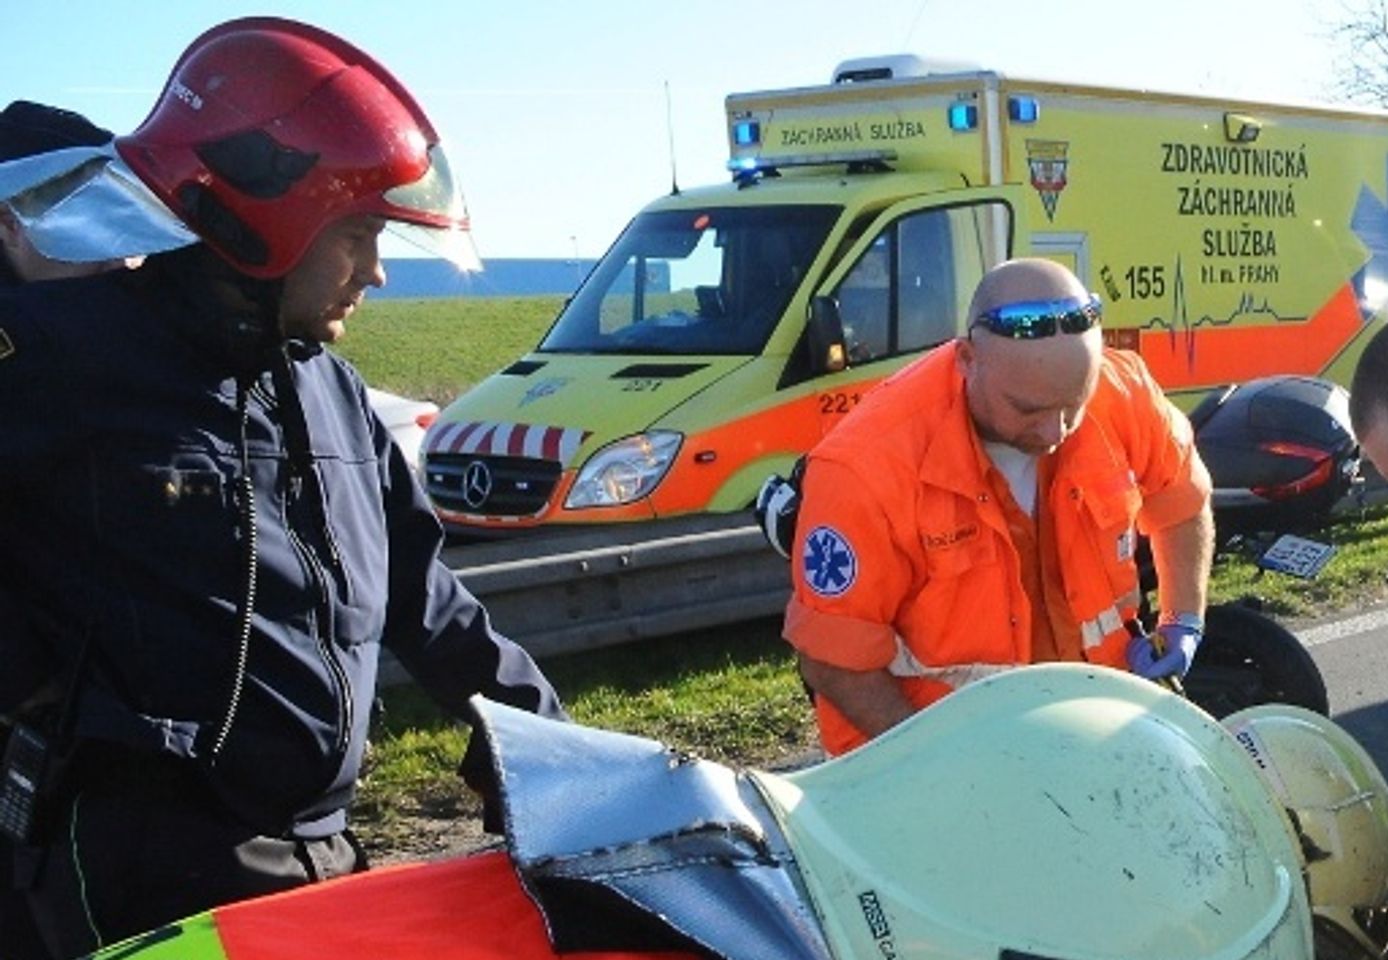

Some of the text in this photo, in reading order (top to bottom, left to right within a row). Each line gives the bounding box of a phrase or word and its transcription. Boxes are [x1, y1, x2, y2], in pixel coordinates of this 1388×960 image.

[1161, 143, 1308, 178] ZDRAVOTNICKÁ
[1178, 179, 1297, 218] ZÁCHRANNÁ
[1203, 222, 1276, 256] SLUŽBA
[1125, 266, 1165, 299] 155
[1239, 265, 1280, 283] PRAHY
[860, 891, 891, 939] MSA
